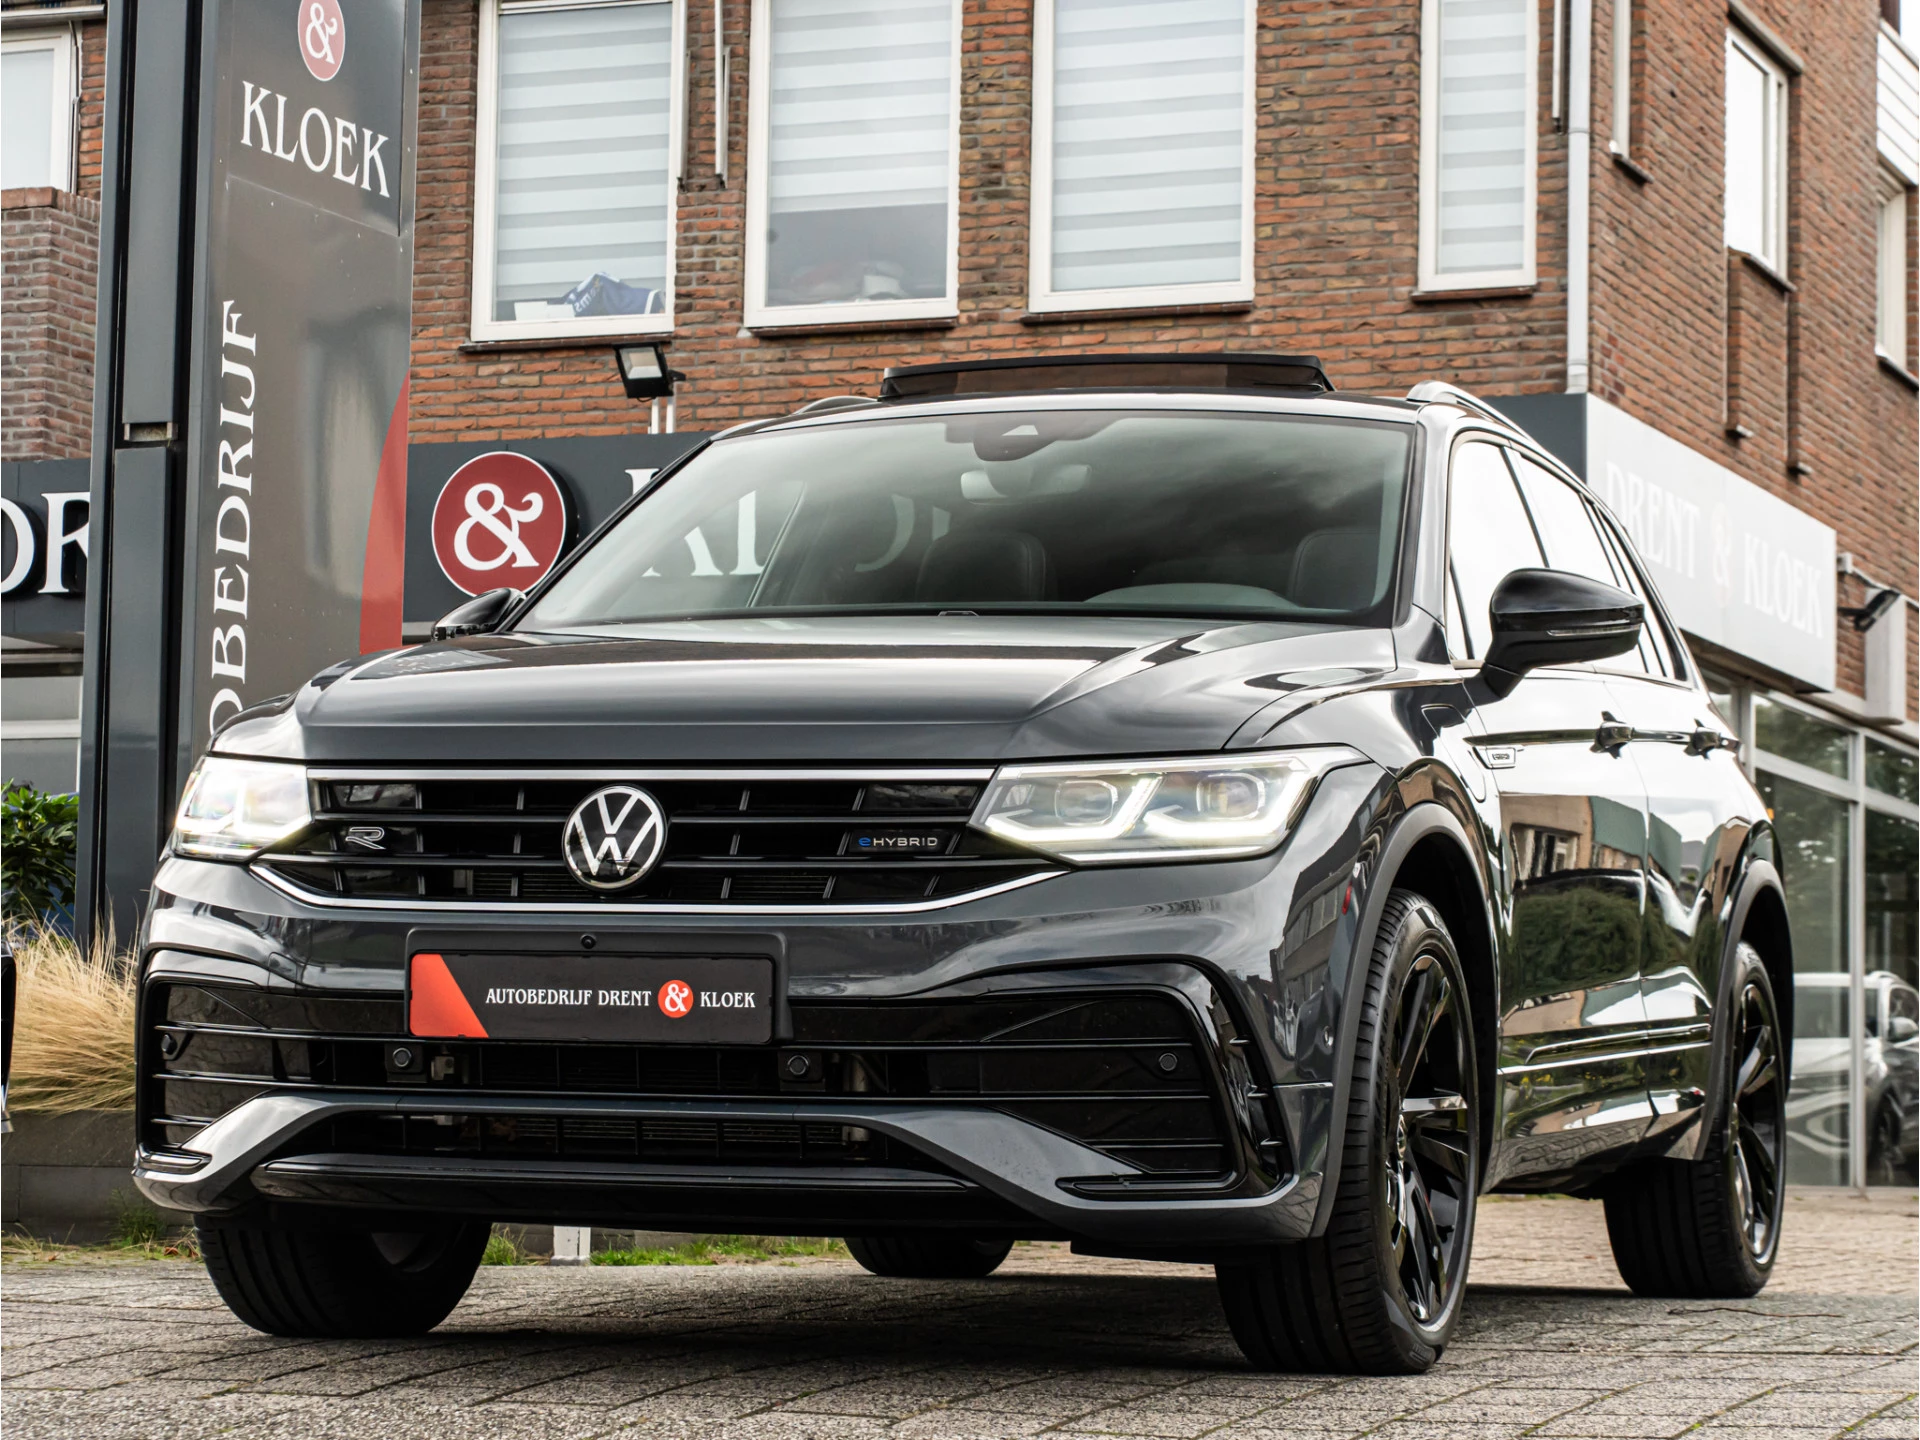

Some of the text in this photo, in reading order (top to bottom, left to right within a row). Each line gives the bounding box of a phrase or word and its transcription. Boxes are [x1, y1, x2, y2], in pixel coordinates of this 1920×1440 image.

[305, 2, 338, 65] &
[240, 80, 390, 198] KLOEK
[453, 482, 544, 571] &
[1606, 460, 1701, 579] DRENT
[1744, 532, 1825, 640] KLOEK
[345, 826, 386, 849] R
[485, 983, 756, 1012] AUTOBEDRIJF DRENT & KLOEK
